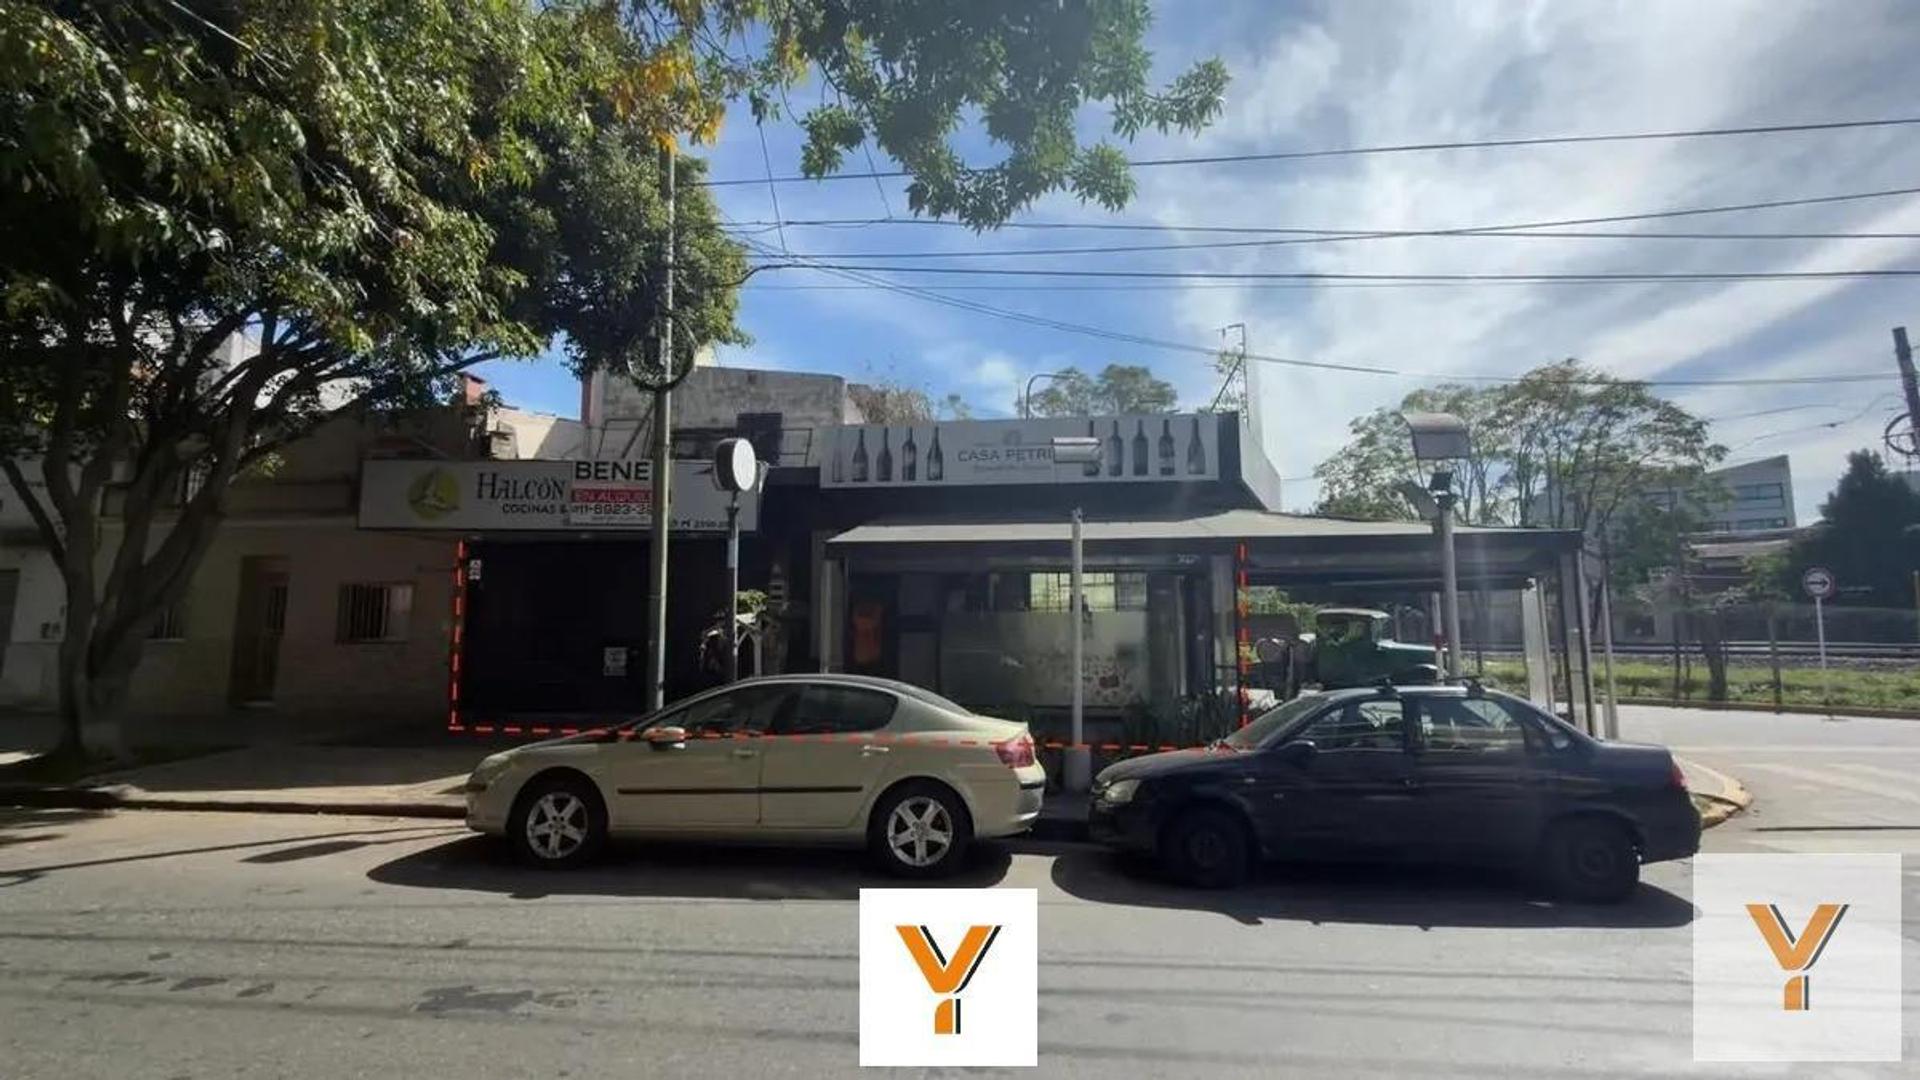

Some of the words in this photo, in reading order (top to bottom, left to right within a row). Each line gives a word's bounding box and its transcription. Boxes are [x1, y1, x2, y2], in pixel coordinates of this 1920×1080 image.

[958, 449, 999, 462] CASA
[575, 461, 650, 480] BENE
[502, 503, 556, 514] COCINAS
